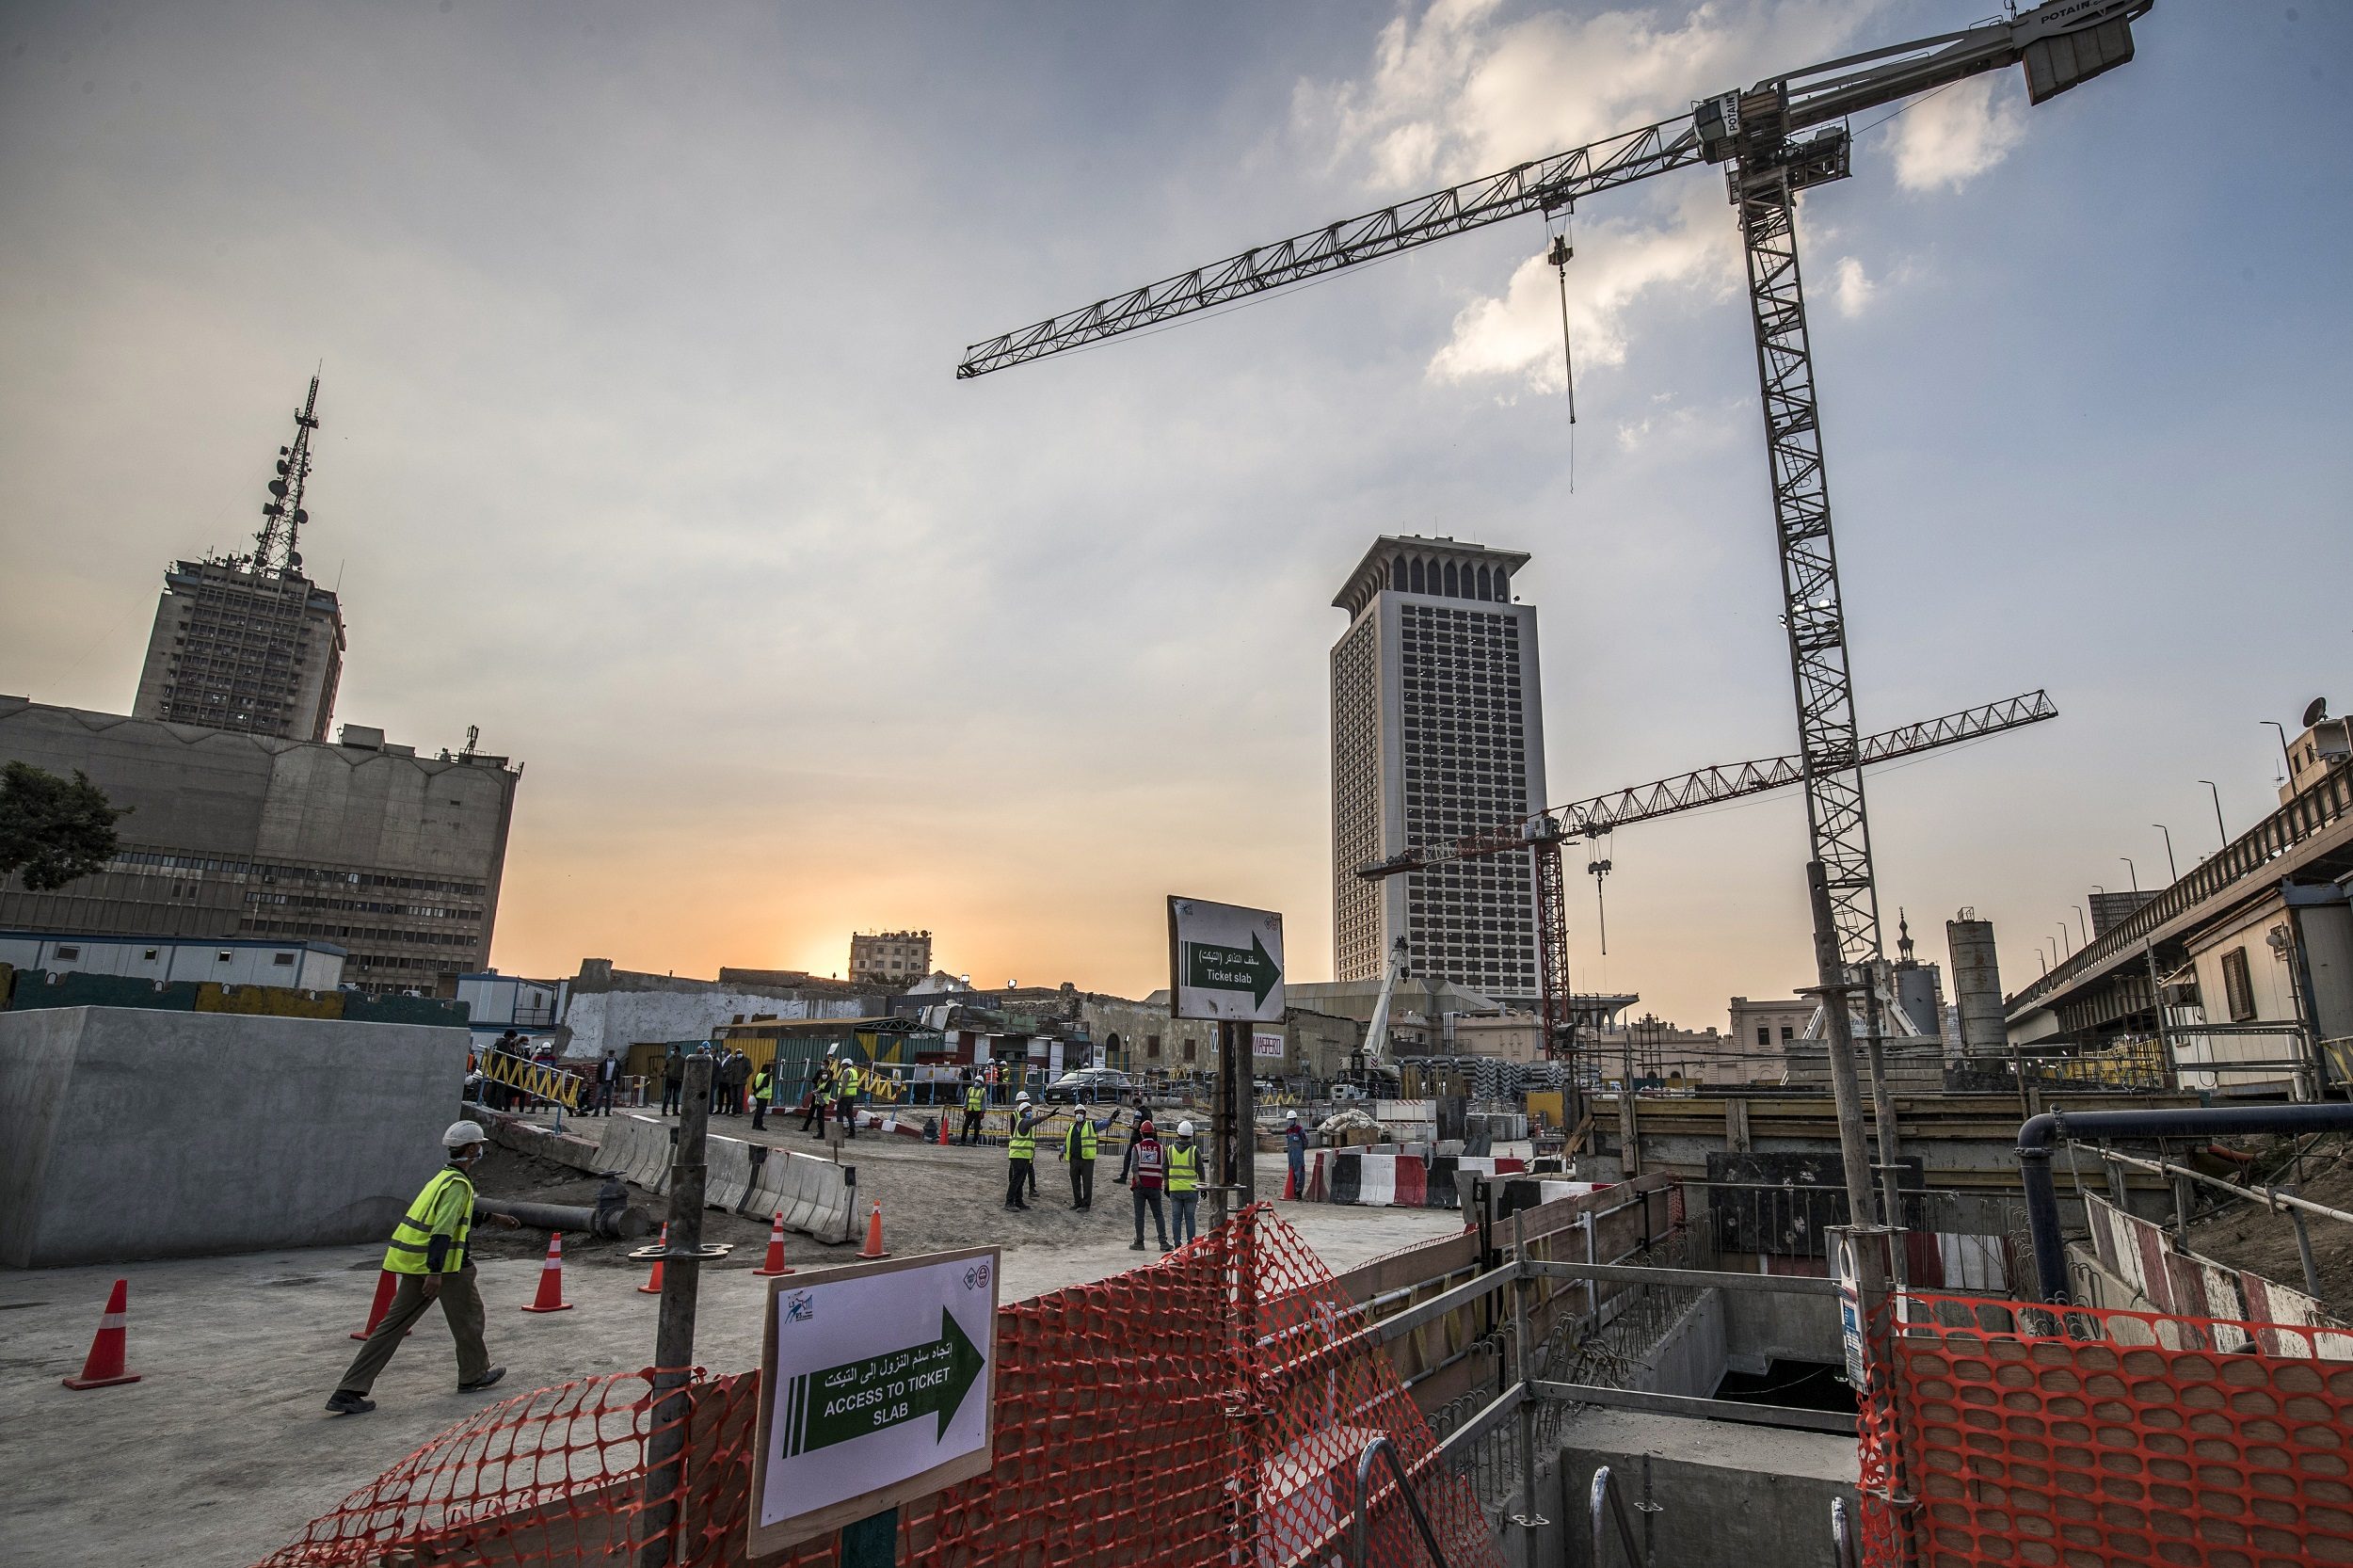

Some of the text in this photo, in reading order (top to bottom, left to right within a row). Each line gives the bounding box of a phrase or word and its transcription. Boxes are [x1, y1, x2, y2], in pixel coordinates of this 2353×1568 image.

[2041, 0, 2090, 24] POTAIN
[1726, 96, 1737, 132] POTAIN
[1243, 955, 1259, 966] سقف
[1207, 968, 1252, 984] Ticket slab
[879, 1353, 909, 1376] النزول
[912, 1350, 929, 1369] سلم
[824, 1367, 857, 1388] التيكت
[860, 1362, 876, 1384] إلى
[824, 1367, 951, 1417] ACCESS TO TICKET
[872, 1401, 908, 1426] SLAB
